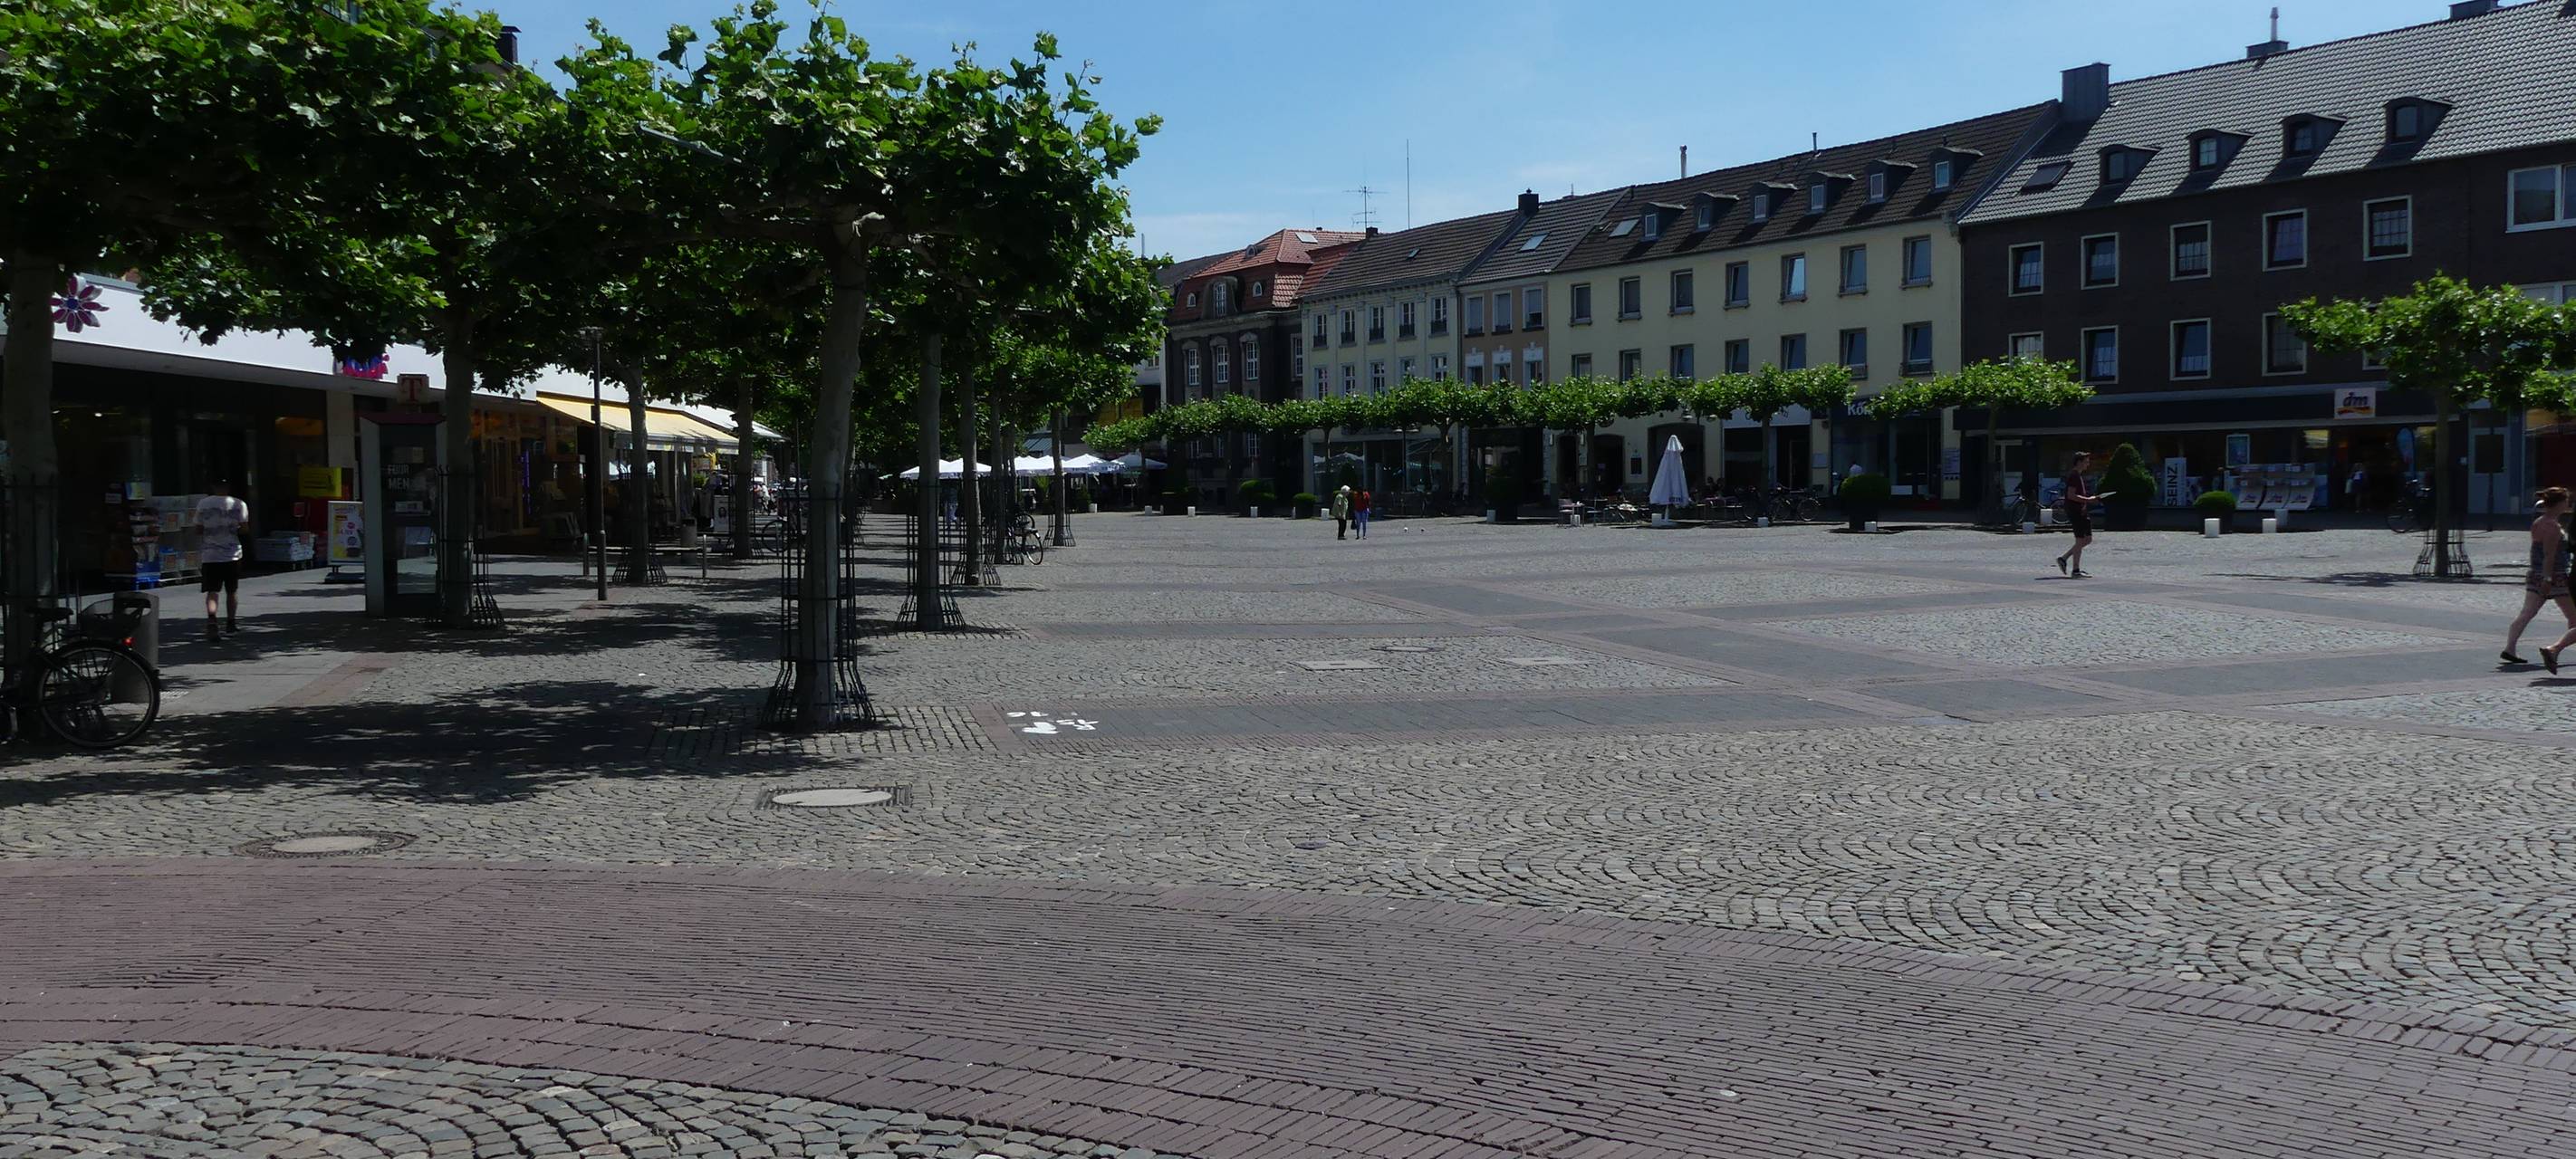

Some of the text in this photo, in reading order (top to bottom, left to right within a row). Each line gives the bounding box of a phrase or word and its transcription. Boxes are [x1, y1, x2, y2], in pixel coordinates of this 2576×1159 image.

[2342, 392, 2369, 407] dm
[388, 477, 410, 490] MEN
[2167, 463, 2178, 507] SEINZ.
